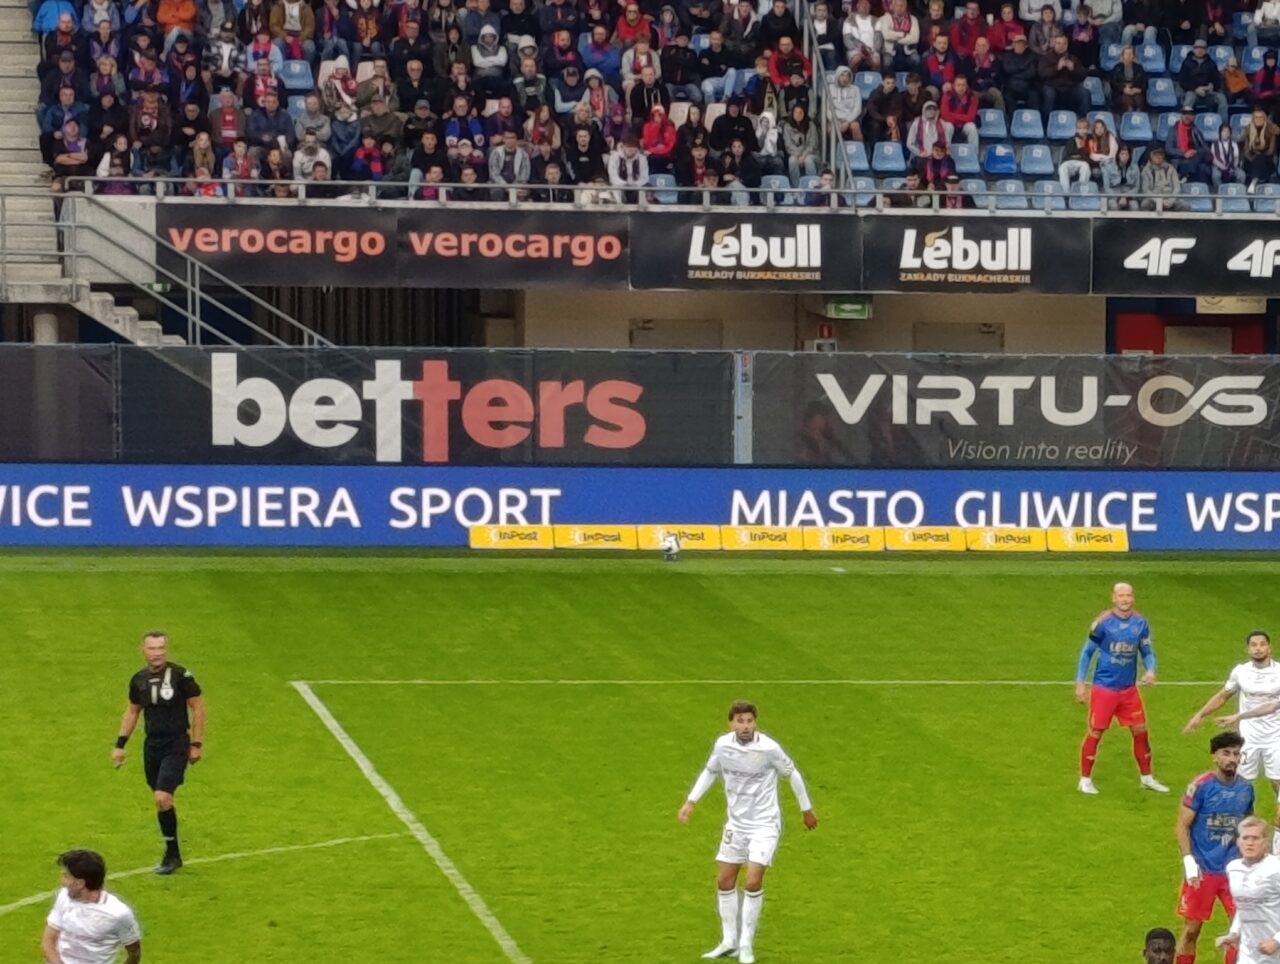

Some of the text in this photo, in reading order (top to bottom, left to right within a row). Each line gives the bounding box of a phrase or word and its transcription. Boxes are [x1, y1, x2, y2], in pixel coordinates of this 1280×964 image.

[169, 226, 385, 262] verocargo
[410, 230, 621, 266] verocargo
[688, 223, 821, 268] Lebull
[899, 226, 1032, 271] Lebull
[1124, 237, 1196, 276] 4F
[211, 352, 646, 463] betters
[949, 437, 1138, 466] Vision into reality
[0, 484, 561, 528] ICE WSPIERA SPORT
[731, 489, 924, 529] MIASTO
[954, 490, 1157, 531] GLIWICE
[500, 531, 538, 541] InPost
[583, 532, 622, 542] InPost
[750, 531, 787, 541] InPost
[831, 534, 870, 544] InPost
[994, 534, 1031, 544] InPost
[1075, 533, 1113, 544] InPost
